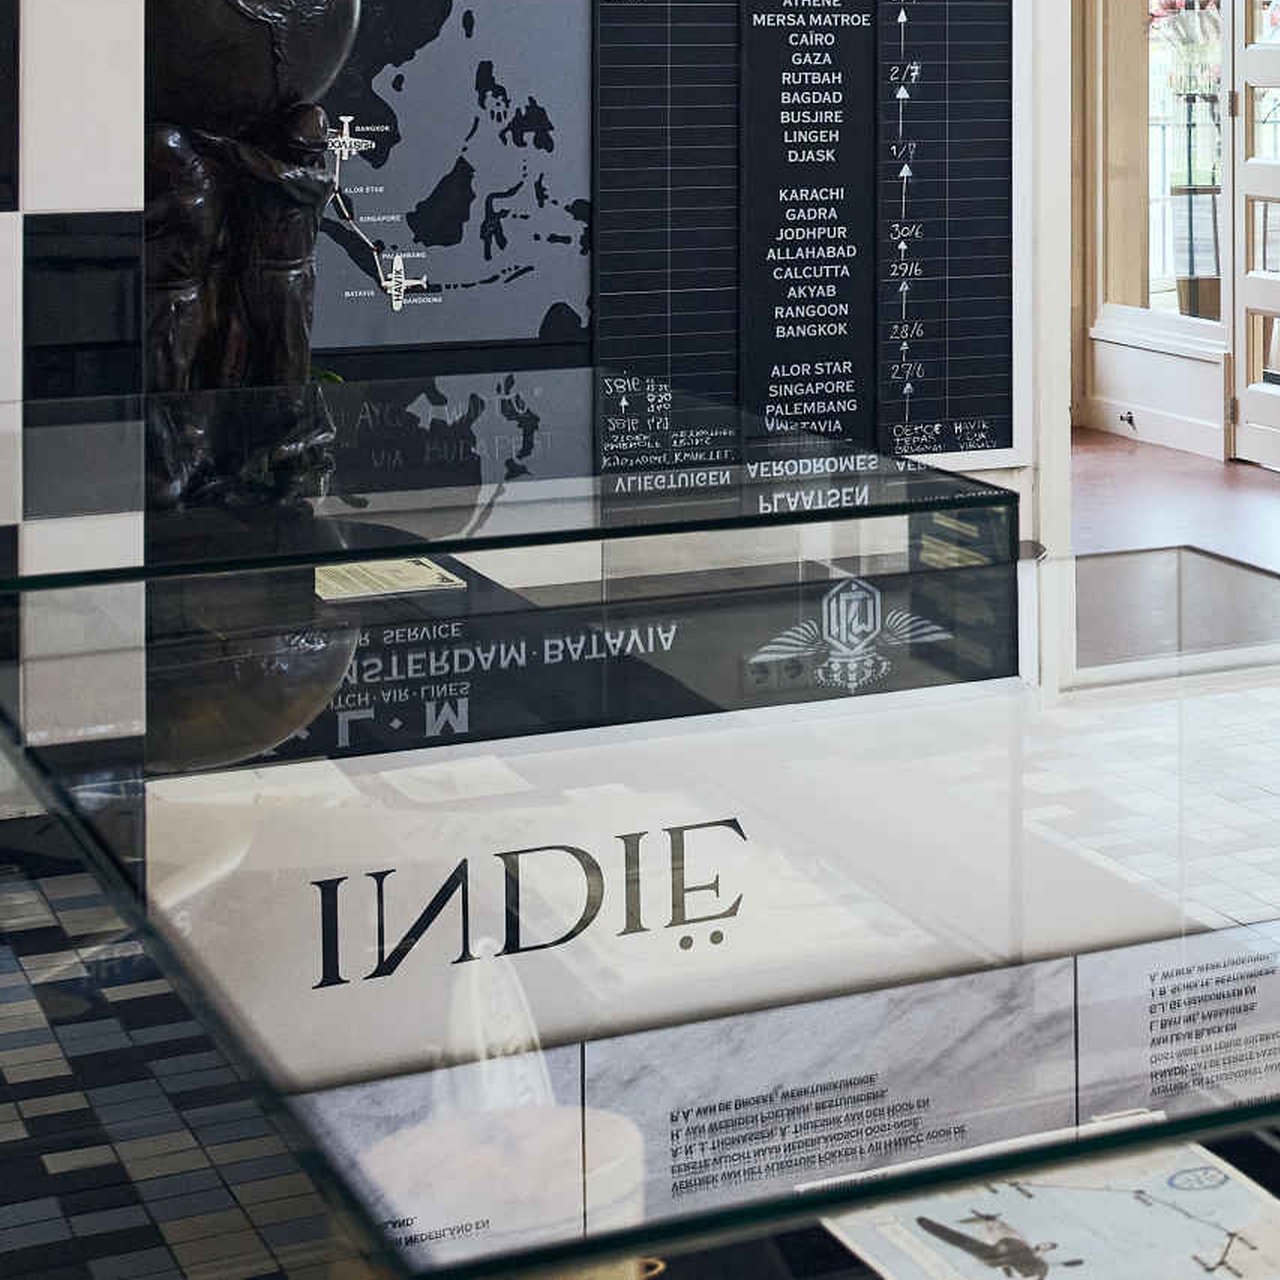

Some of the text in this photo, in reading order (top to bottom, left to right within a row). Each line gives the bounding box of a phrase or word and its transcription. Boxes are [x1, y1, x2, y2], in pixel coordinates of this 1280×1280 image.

[752, 13, 871, 27] MERSA MATROE
[788, 30, 835, 46] CAÏRO
[791, 52, 832, 65] GAZA
[781, 71, 842, 85] RUTBAH
[780, 90, 843, 104] BAGDAD
[780, 110, 843, 124] BUSJIRE
[783, 129, 839, 143] LINGEH
[787, 148, 836, 163] DJASK
[778, 186, 845, 202] KARACHI
[785, 206, 838, 221] GADRA
[775, 225, 847, 241] JODHPUR
[765, 244, 857, 261] ALLAHABAD
[772, 264, 850, 280] CALCUTTA
[786, 284, 837, 299] AKYAB
[774, 302, 849, 319] RANGOON
[775, 321, 848, 338] BANGKOK
[770, 360, 853, 378] ALOR STAR
[768, 379, 855, 398] SINGAPORE
[765, 398, 857, 417] PALEMBANG
